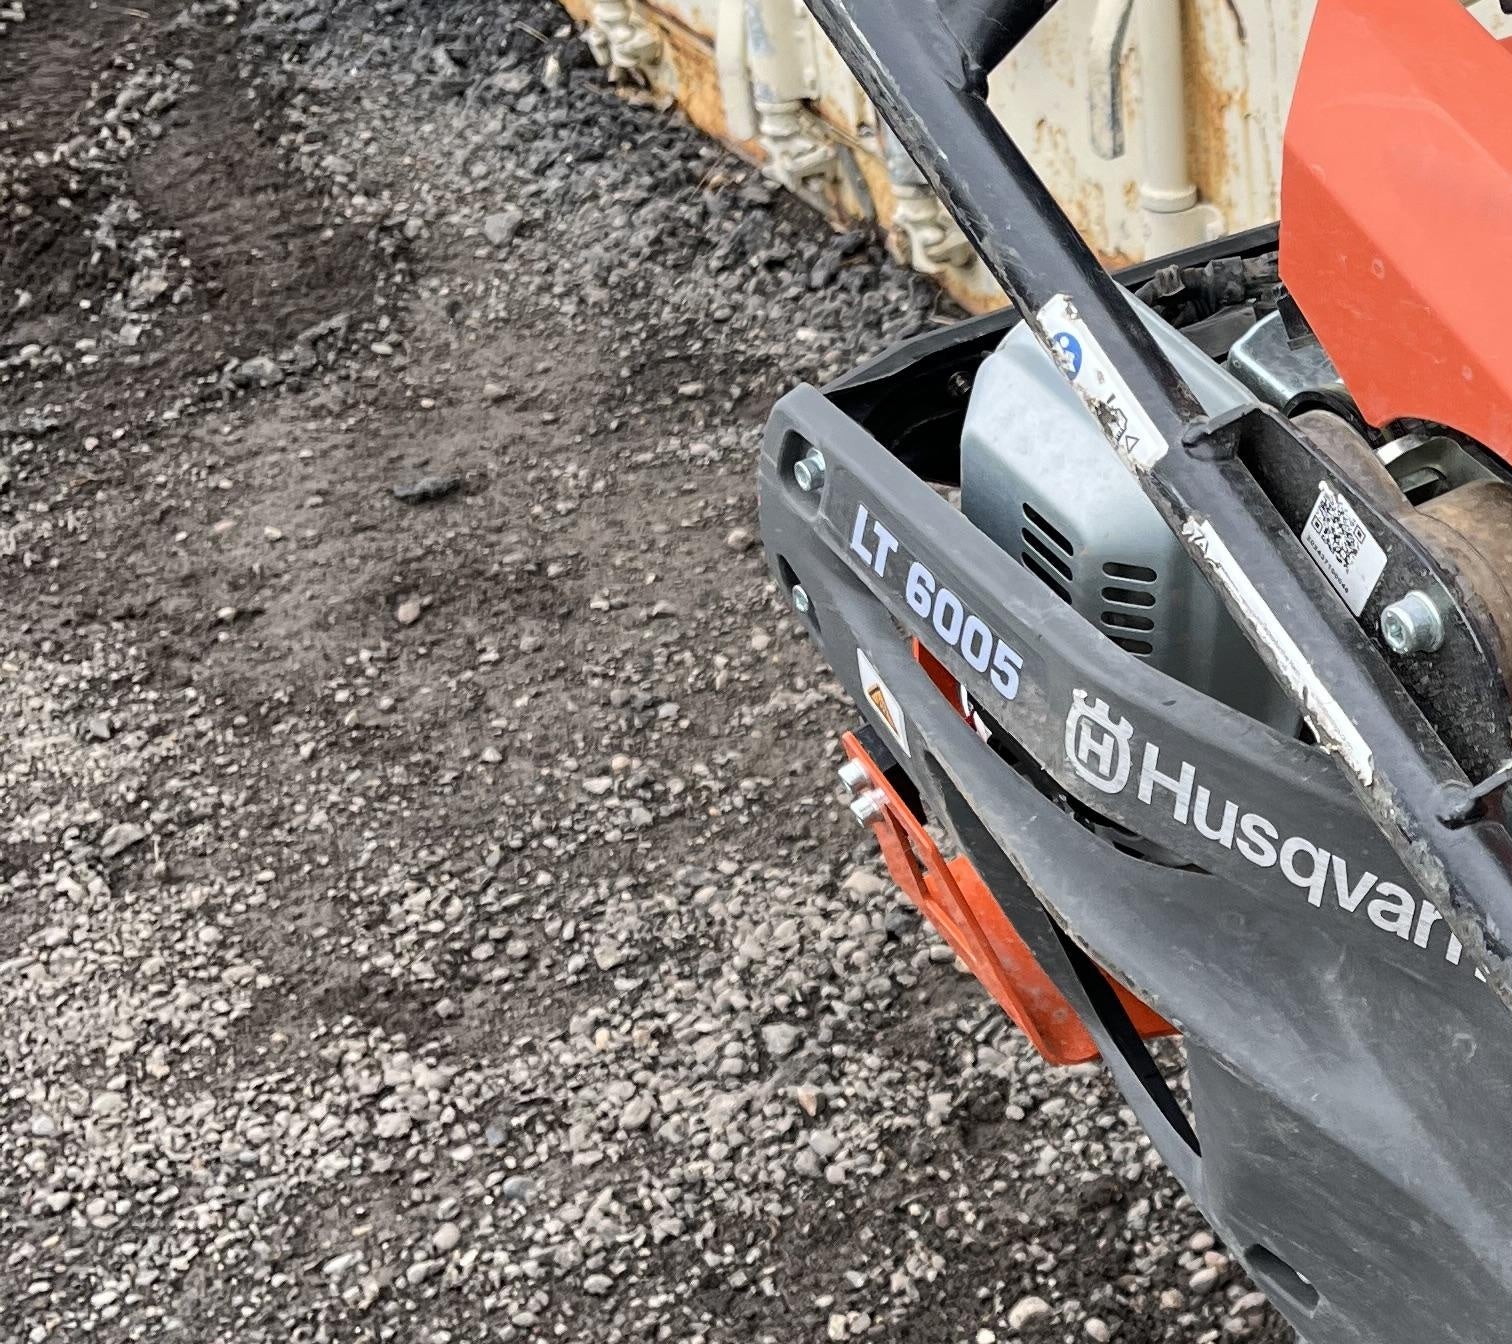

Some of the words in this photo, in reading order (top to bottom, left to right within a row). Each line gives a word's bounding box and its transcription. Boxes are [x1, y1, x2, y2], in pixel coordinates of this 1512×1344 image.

[850, 503, 899, 578] LT
[905, 560, 1024, 701] 6005
[1137, 741, 1489, 984] Husqvar
